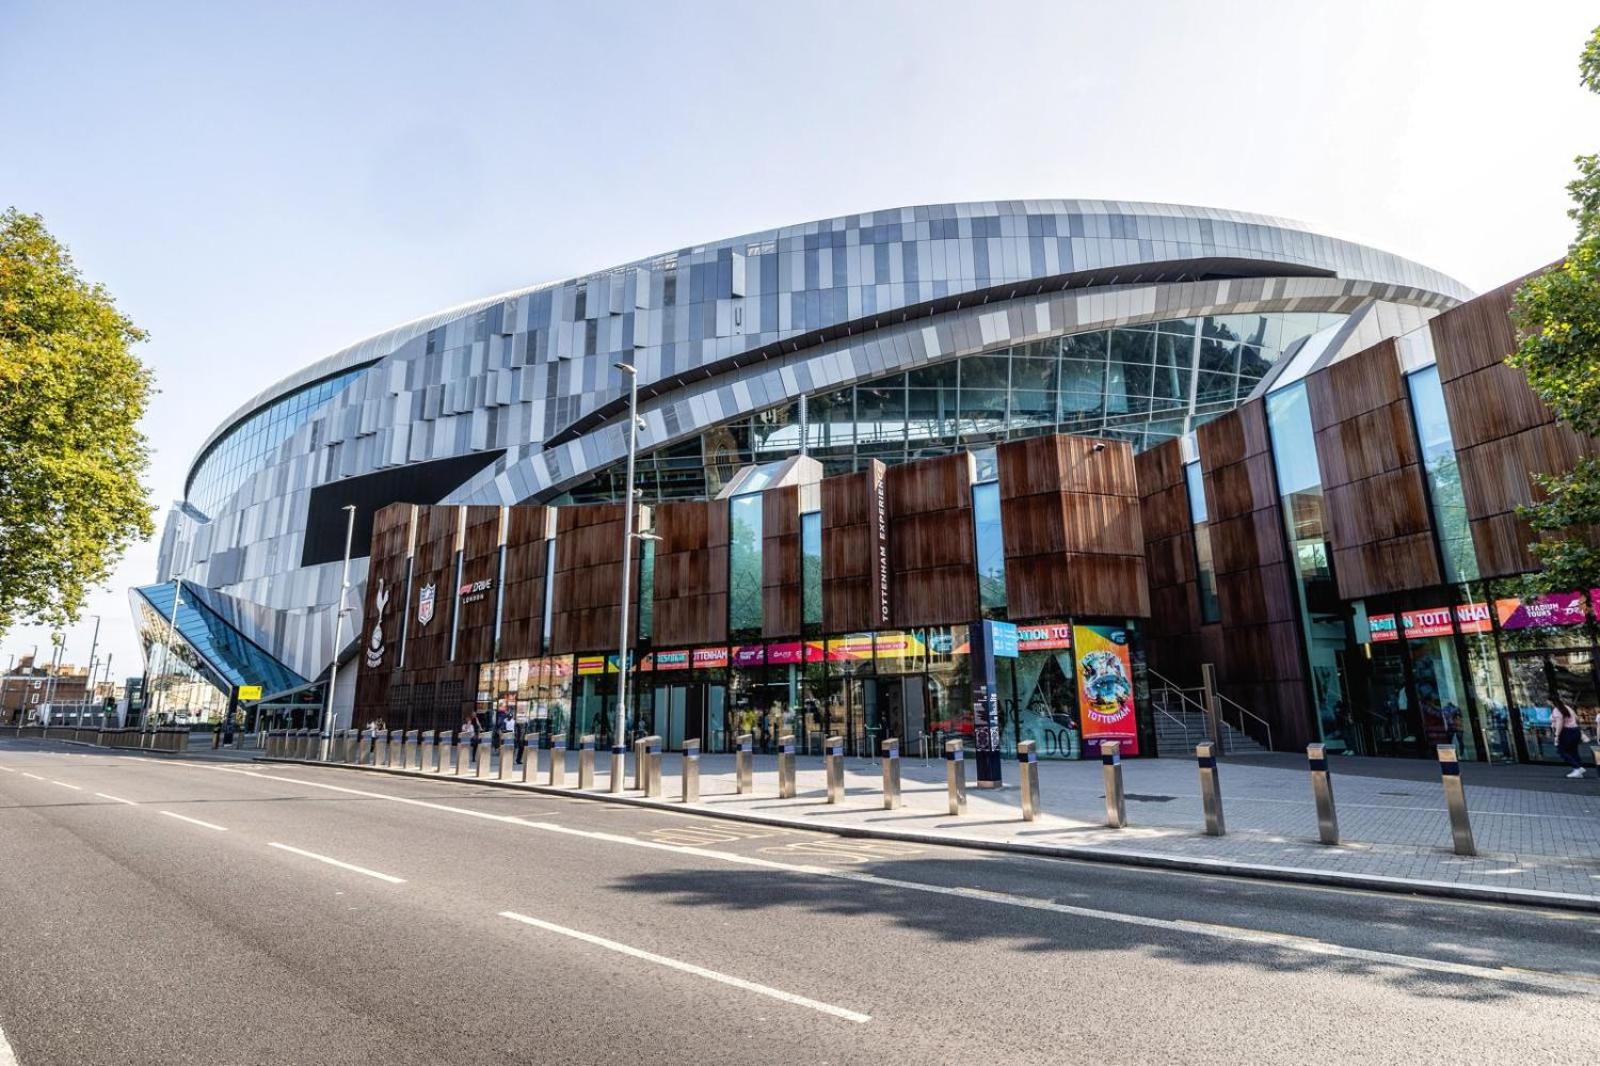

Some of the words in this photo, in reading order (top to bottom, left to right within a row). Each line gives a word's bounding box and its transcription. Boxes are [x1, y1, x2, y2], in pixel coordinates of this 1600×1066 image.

[877, 465, 887, 540] EXPERIENCE
[880, 546, 889, 622] TOTTENHAM
[462, 594, 484, 605] LONDON
[1526, 603, 1559, 612] STADIUM
[1527, 610, 1552, 618] TOURS
[1087, 705, 1131, 725] TOTTENHAM
[1044, 728, 1071, 758] DO
